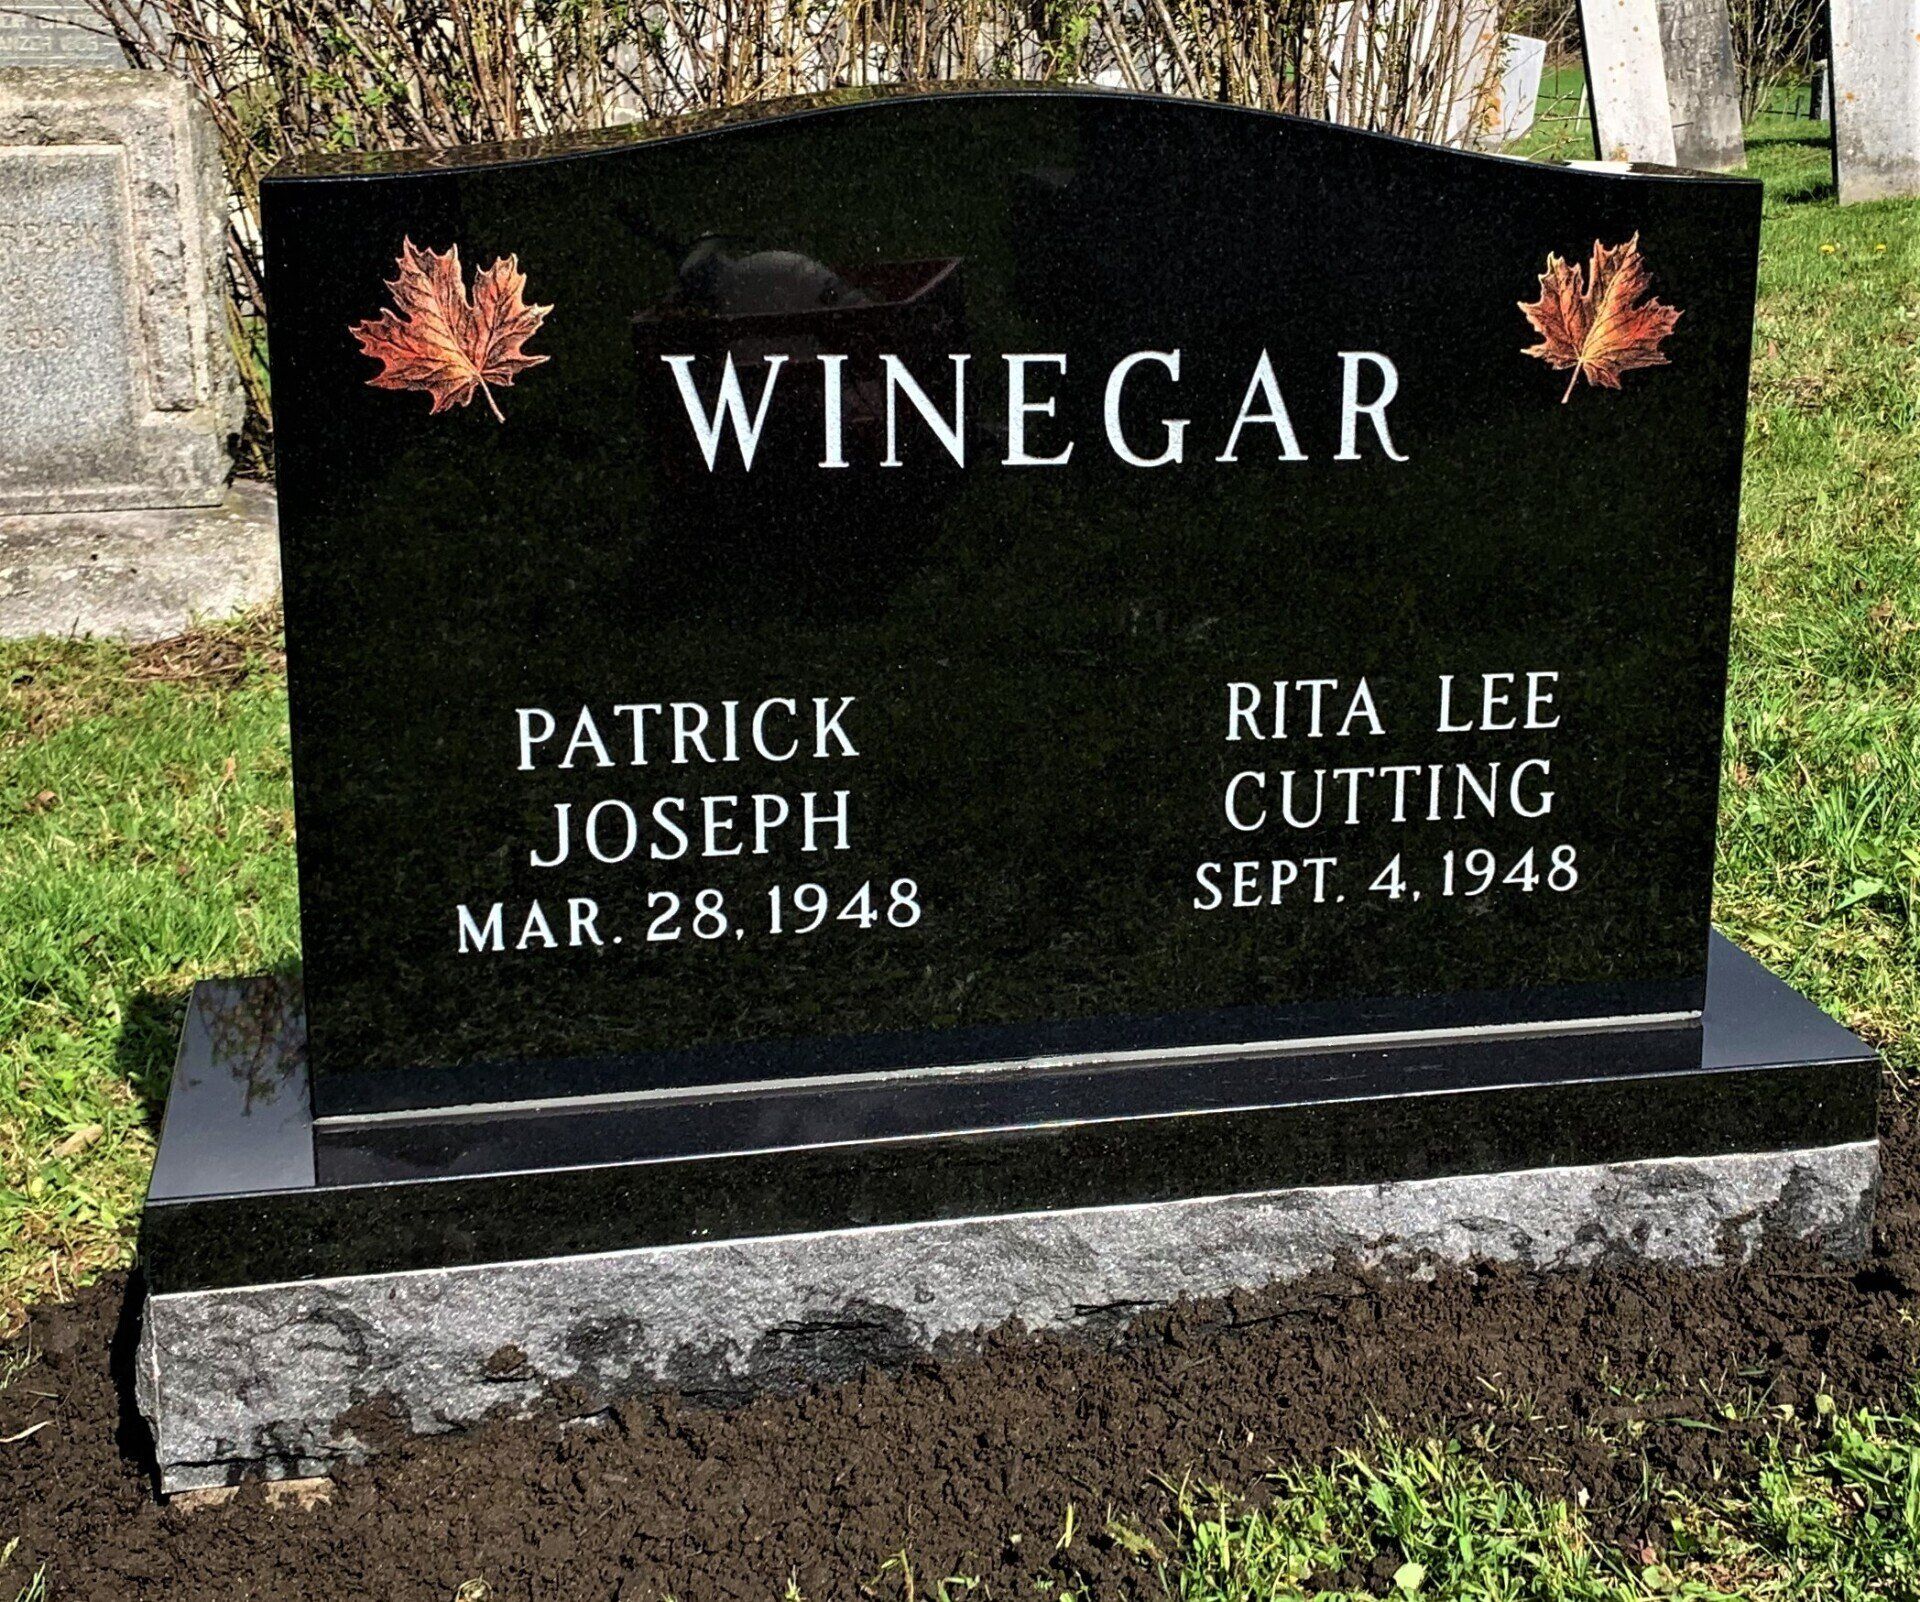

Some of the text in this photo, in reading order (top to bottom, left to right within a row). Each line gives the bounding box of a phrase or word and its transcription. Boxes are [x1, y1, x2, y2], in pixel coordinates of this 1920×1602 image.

[660, 348, 1410, 473] WINEGAR
[515, 696, 860, 771] PATRICK
[1225, 671, 1561, 741] RITA LEE
[530, 790, 851, 867] JOSEPH
[1224, 758, 1555, 832] CUTTING
[1193, 844, 1579, 911] SEPT. 4, 1948
[456, 877, 922, 954] MAR. 28, 1948
